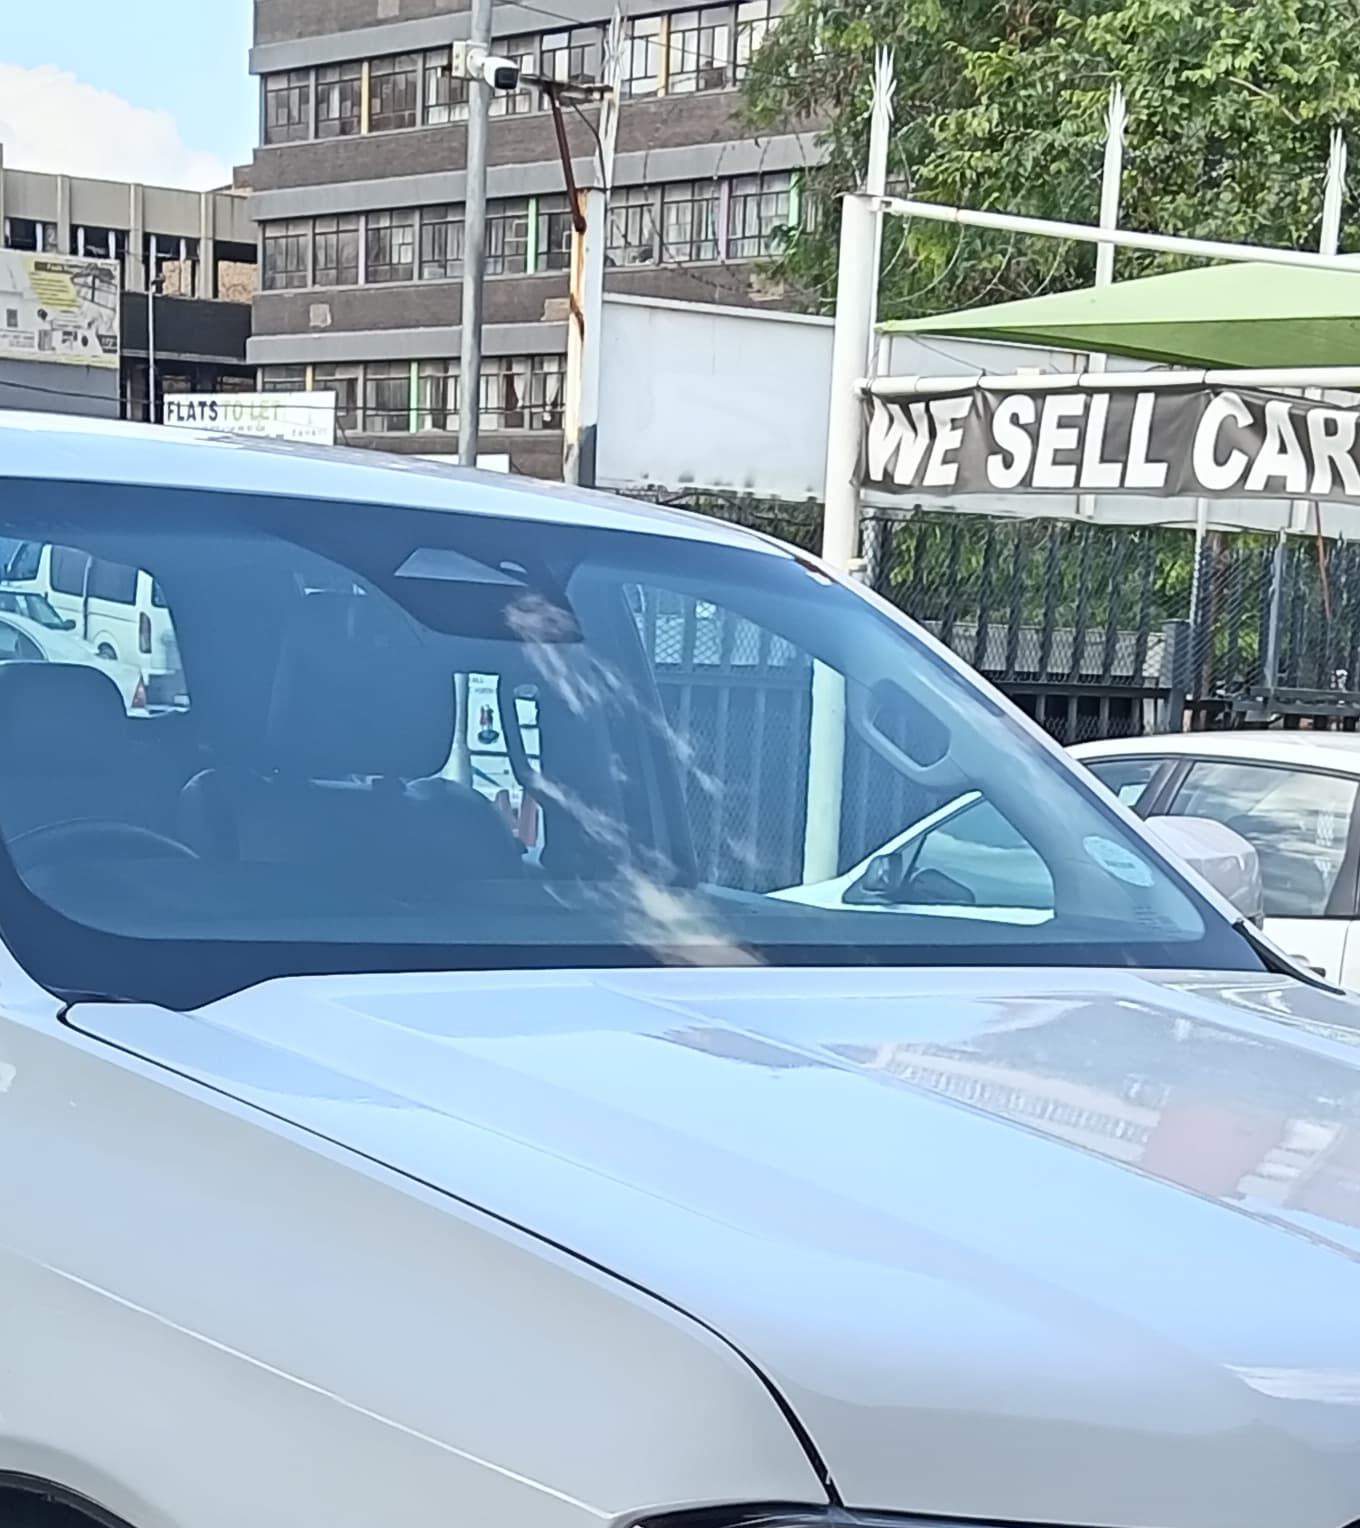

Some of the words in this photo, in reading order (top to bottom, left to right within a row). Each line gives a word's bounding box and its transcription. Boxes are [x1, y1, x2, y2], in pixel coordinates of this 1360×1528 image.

[167, 399, 219, 422] FLATS
[223, 399, 244, 422] TO
[249, 400, 280, 422] LET
[864, 395, 971, 487] WE
[987, 392, 1172, 489] SELL
